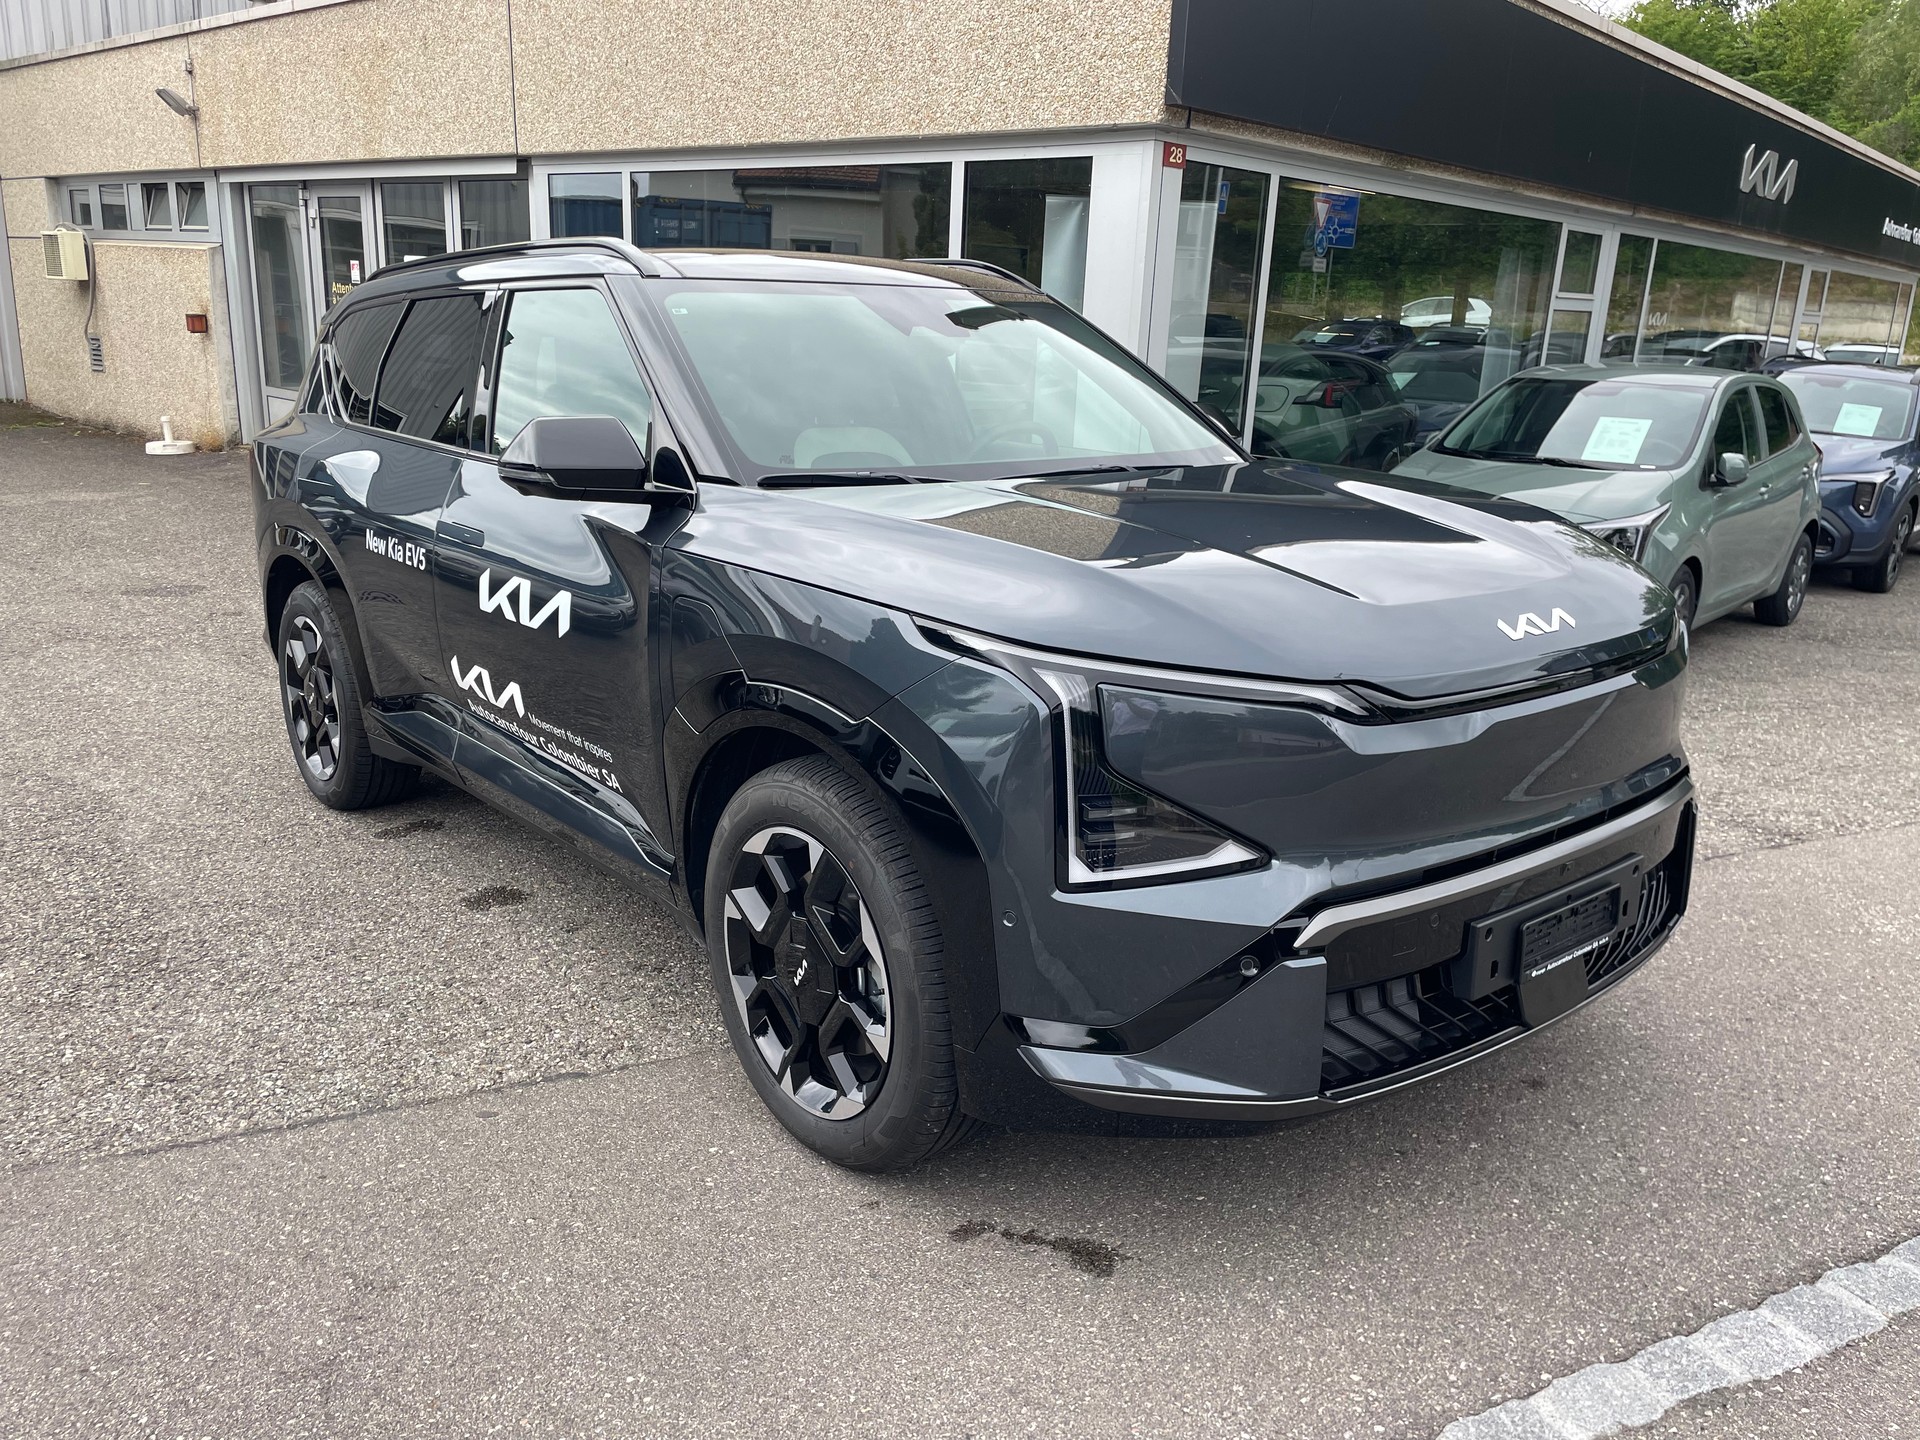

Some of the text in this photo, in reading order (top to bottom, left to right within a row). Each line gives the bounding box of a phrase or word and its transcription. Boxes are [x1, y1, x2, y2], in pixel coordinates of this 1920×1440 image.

[1169, 146, 1183, 164] 28
[1740, 143, 1799, 205] KIA
[332, 281, 357, 294] Attent
[365, 528, 426, 571] New Kia EV5
[479, 568, 572, 639] KIA
[1496, 607, 1576, 642] KIA
[450, 655, 525, 719] KIA
[467, 698, 624, 794] Autocarrefour Colombier SA
[528, 712, 613, 763] Movement that inspires
